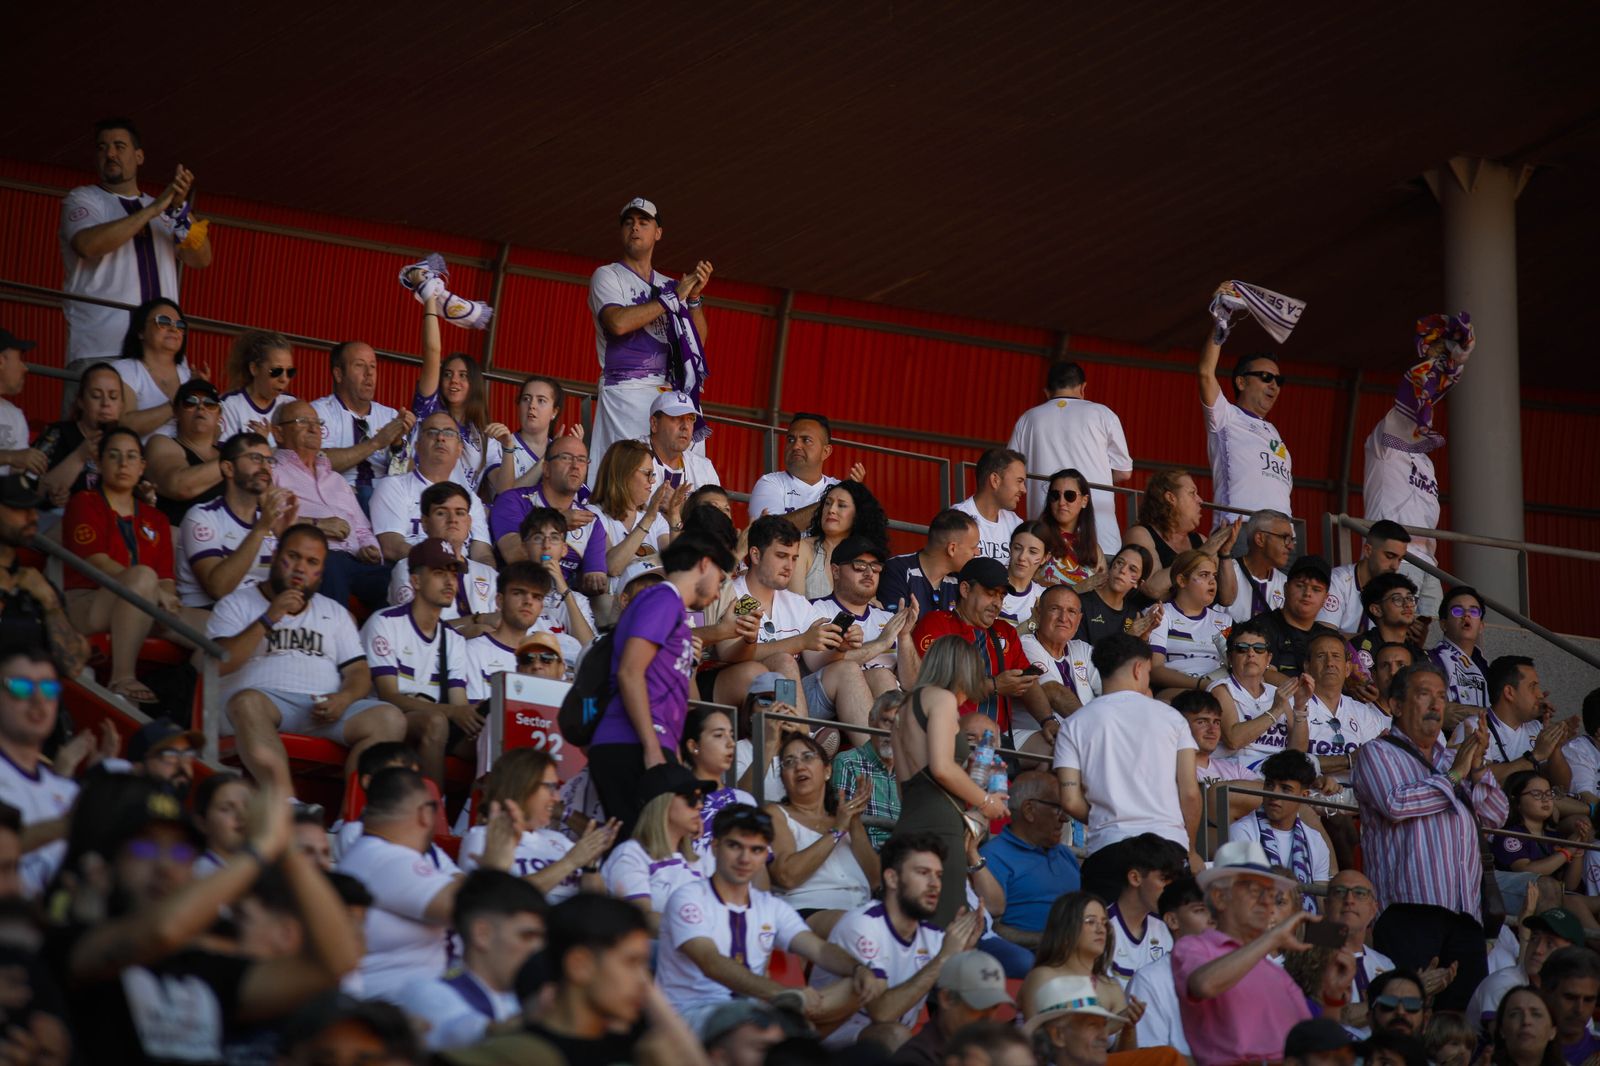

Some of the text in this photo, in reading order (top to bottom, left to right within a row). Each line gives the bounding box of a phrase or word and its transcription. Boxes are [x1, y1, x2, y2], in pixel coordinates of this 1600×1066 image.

[1267, 294, 1285, 310] SE
[979, 540, 1010, 558] UES
[266, 627, 323, 653] MIAMI
[515, 712, 552, 729] Sector
[530, 730, 563, 761] 22
